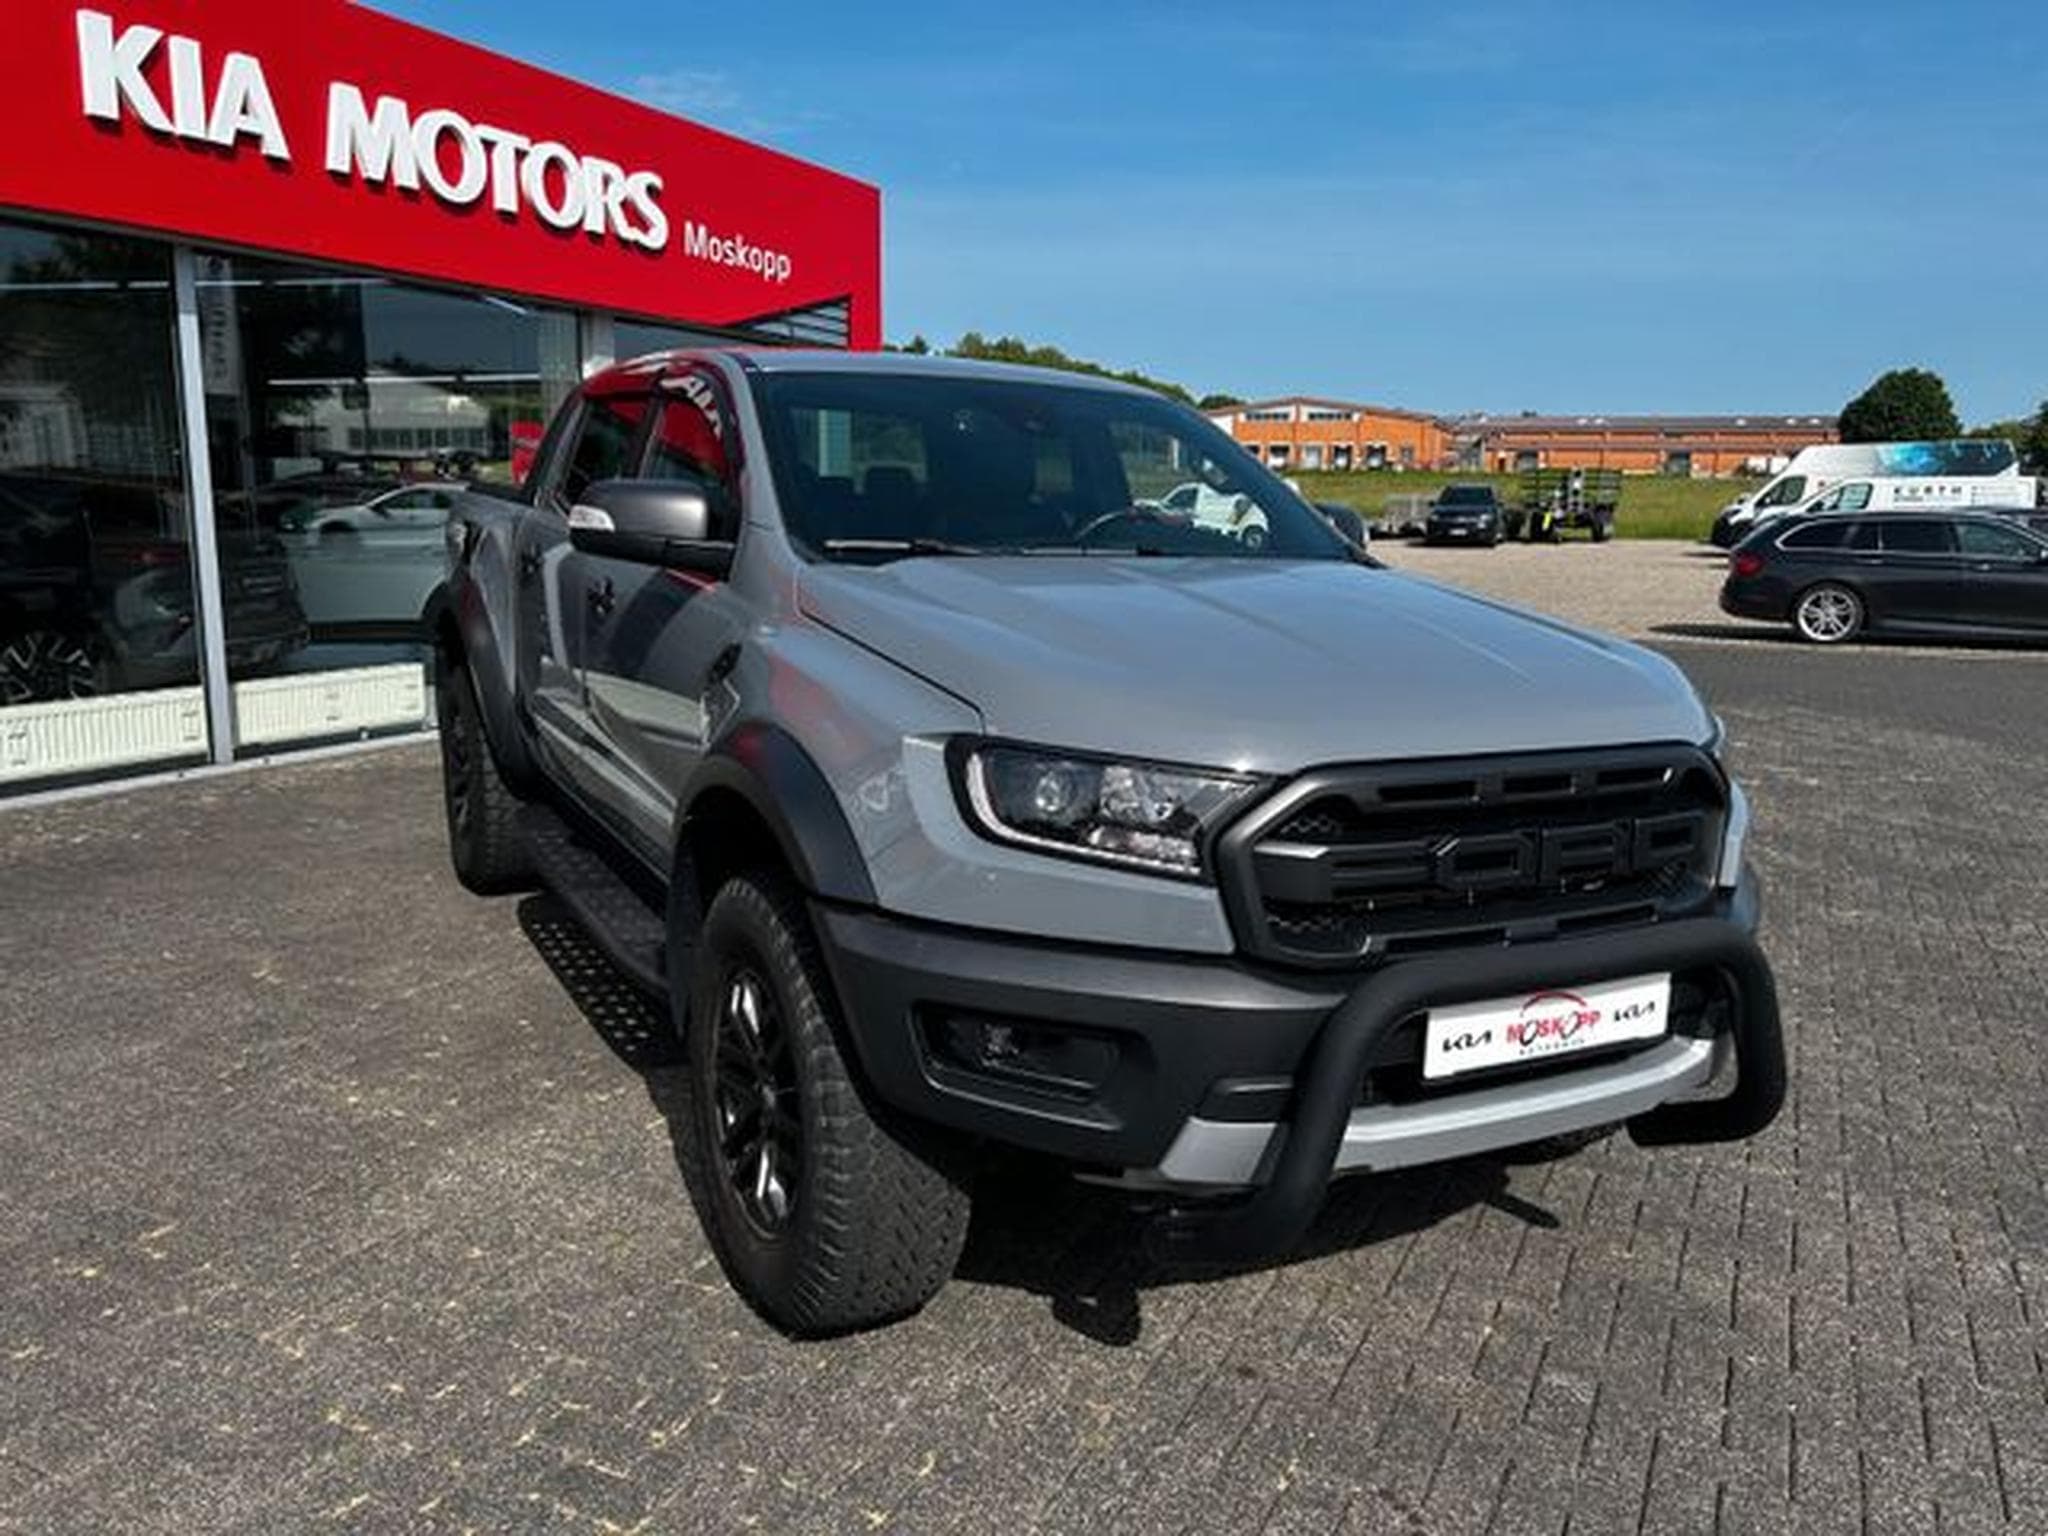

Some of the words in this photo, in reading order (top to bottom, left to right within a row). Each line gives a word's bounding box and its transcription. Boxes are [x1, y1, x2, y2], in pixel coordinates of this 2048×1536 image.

[75, 9, 290, 162] KIA
[325, 81, 669, 251] MOTORS
[683, 219, 792, 283] Moskopp
[1443, 1030, 1492, 1052] KIA
[1613, 1001, 1656, 1022] KIA
